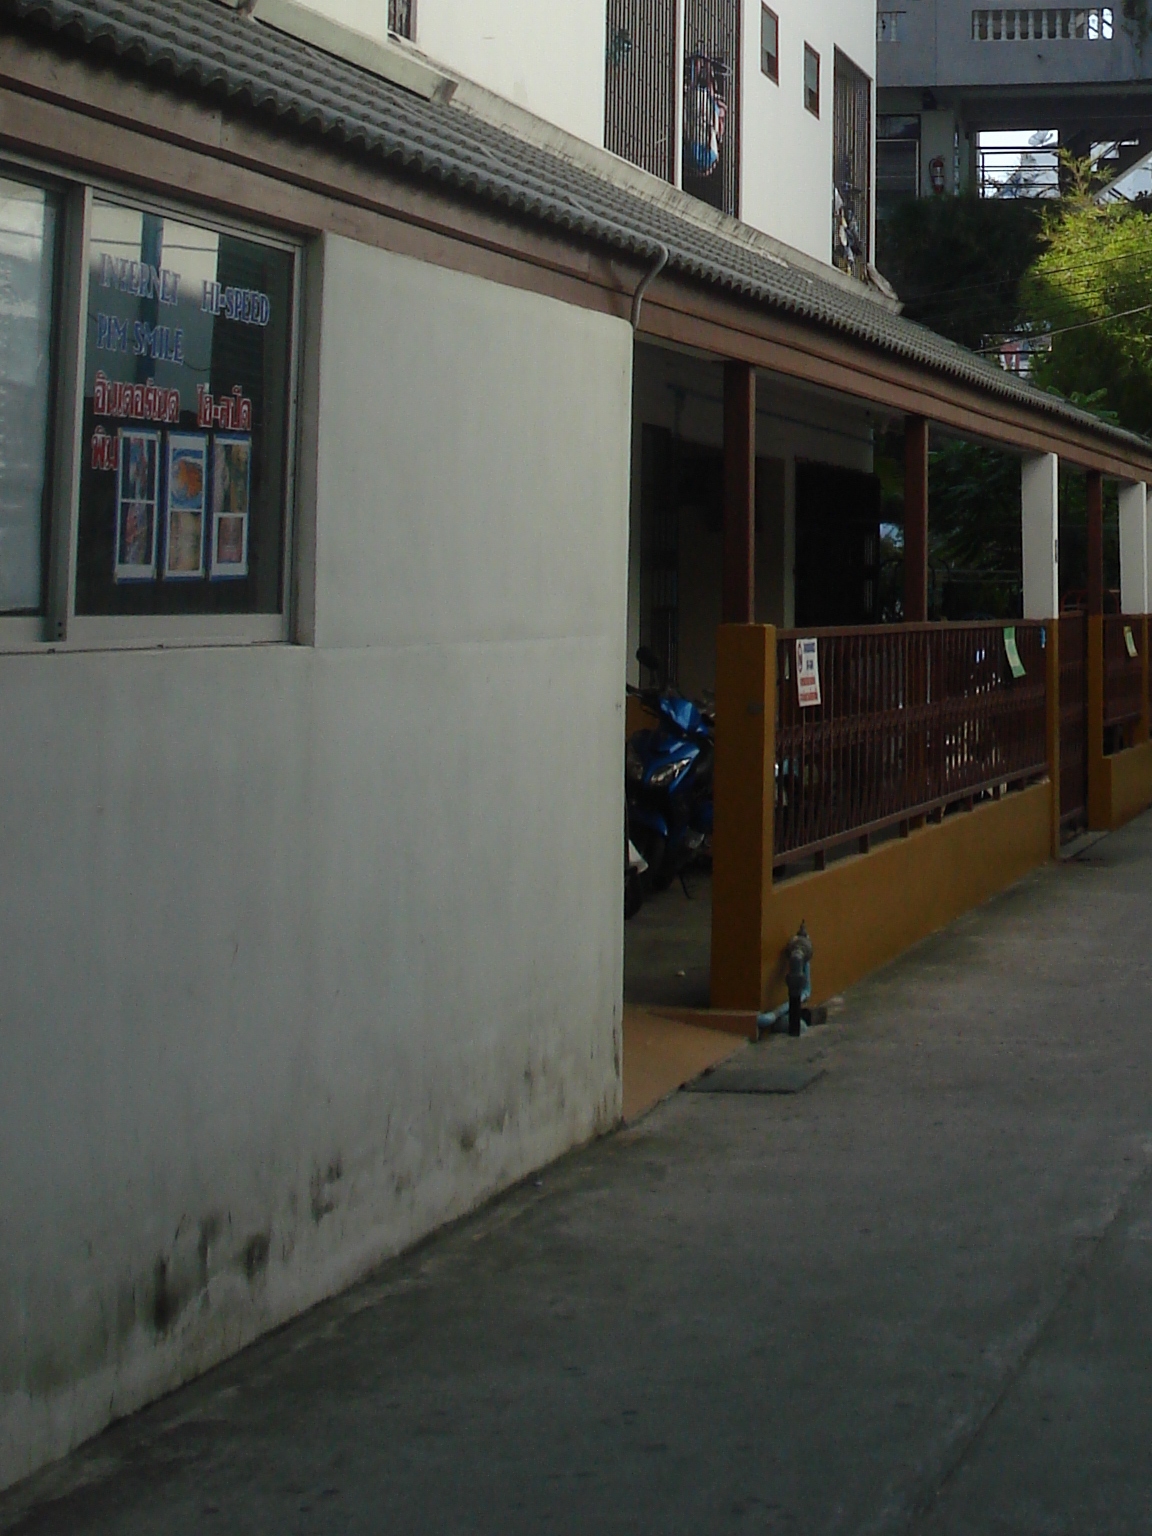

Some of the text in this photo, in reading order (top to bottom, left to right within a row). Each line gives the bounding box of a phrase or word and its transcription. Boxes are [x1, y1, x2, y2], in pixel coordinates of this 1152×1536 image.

[99, 252, 271, 327] INTERNET HI-SPEED
[96, 312, 185, 365] PIM SMILE
